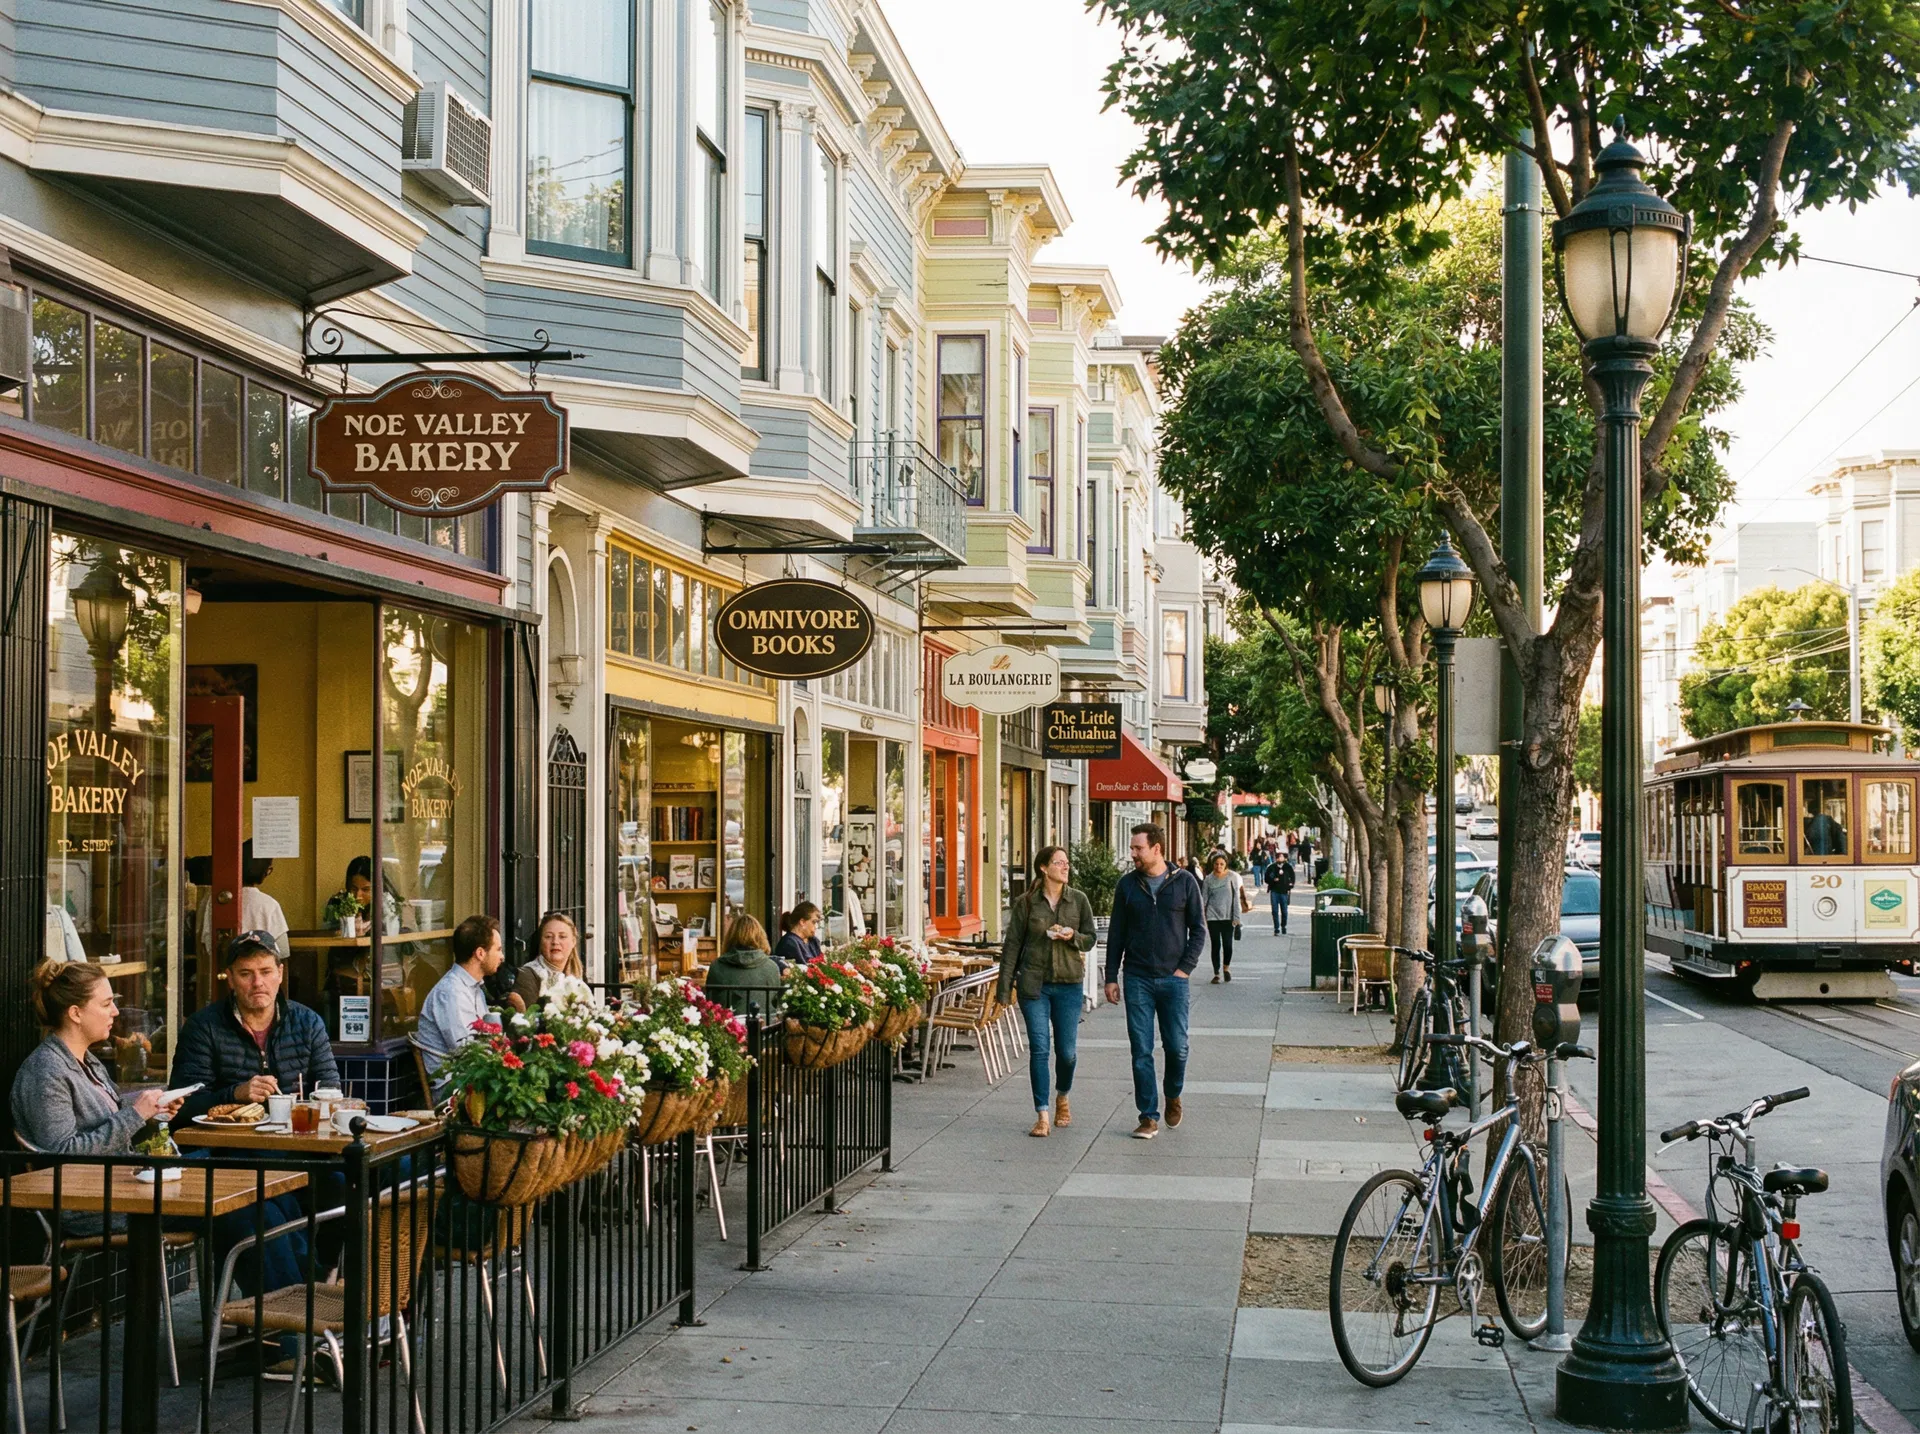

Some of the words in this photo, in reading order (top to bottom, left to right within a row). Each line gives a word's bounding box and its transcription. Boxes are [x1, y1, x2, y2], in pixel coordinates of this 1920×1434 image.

[344, 413, 407, 437] NOE
[414, 412, 532, 436] VALLEY
[354, 441, 520, 472] BAKERY
[728, 609, 860, 630] OMNIVORE
[752, 635, 836, 655] BOOKS
[949, 673, 965, 686] LA
[968, 673, 1053, 686] BOULANGERIE
[1051, 710, 1076, 725] The
[1048, 725, 1117, 740] Chihuahua
[74, 729, 145, 786] VALLEY
[401, 761, 423, 800] NOE
[51, 785, 128, 814] BAKERY
[412, 798, 454, 819] BAKERY
[1810, 874, 1842, 889] 20
